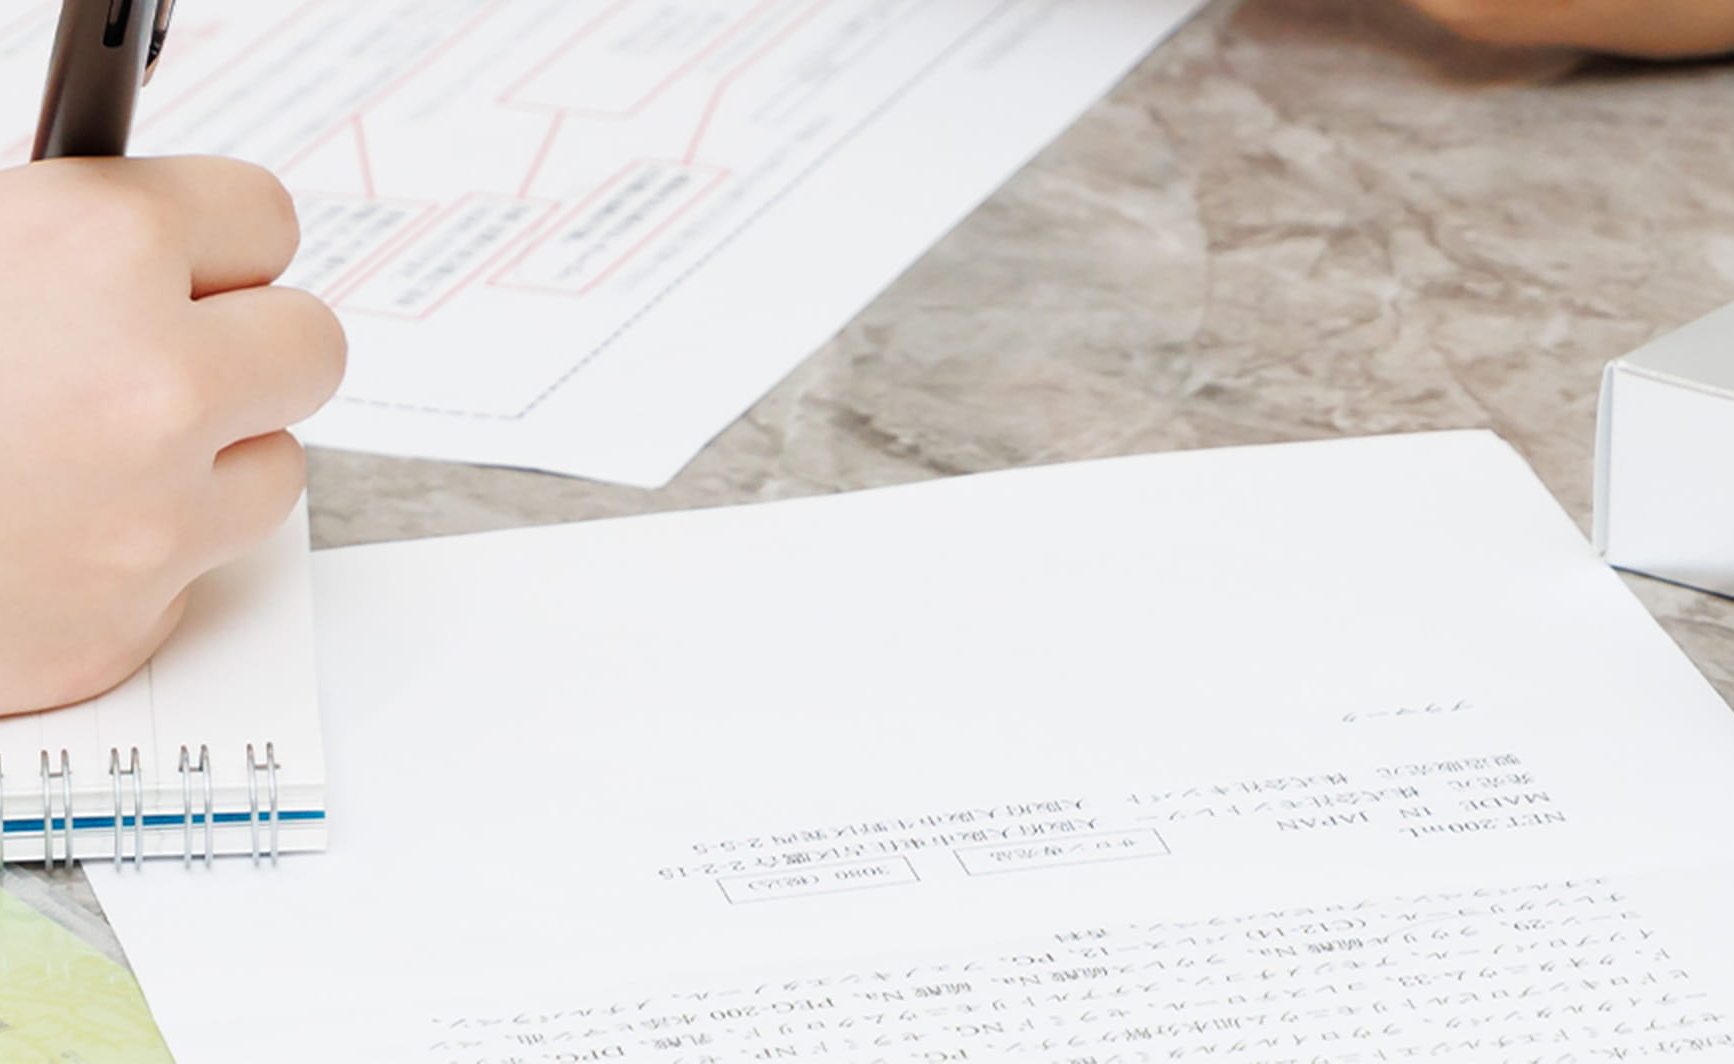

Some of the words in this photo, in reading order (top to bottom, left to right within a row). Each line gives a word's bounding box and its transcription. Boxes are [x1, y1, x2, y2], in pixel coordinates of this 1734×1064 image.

[1398, 805, 1433, 819] IN
[1458, 791, 1551, 812] MADE
[1276, 810, 1369, 832] JAPAN
